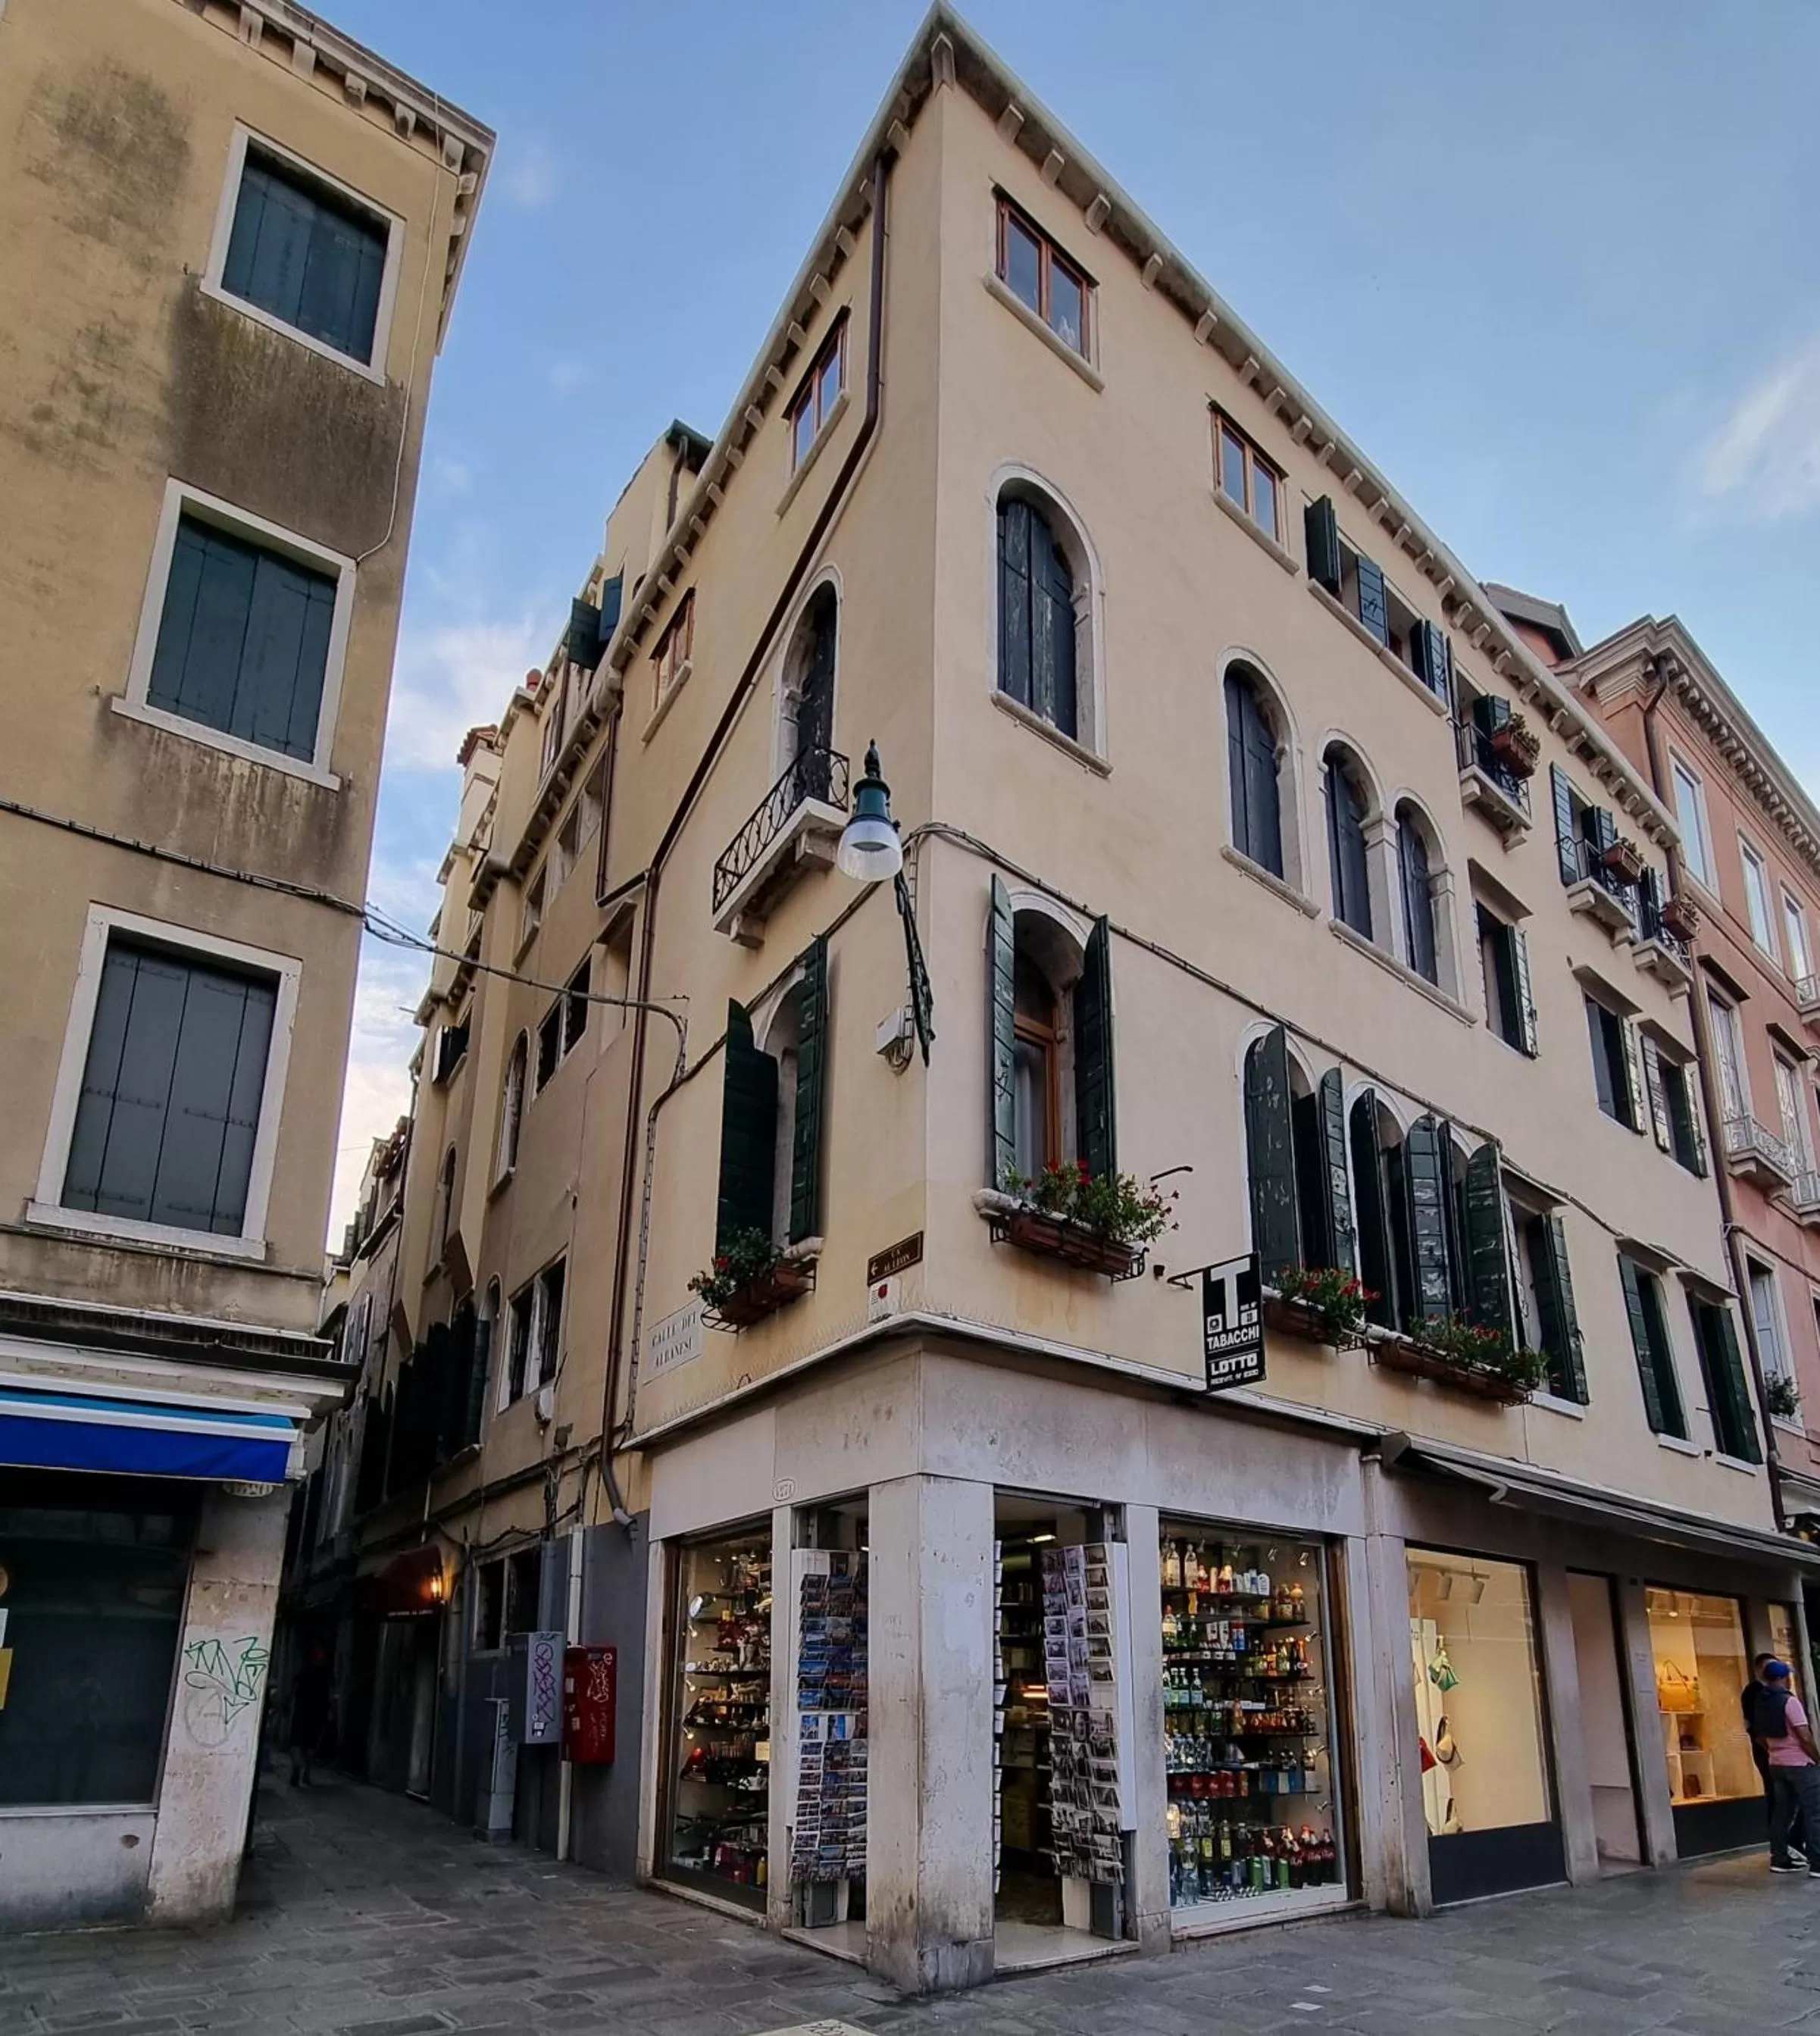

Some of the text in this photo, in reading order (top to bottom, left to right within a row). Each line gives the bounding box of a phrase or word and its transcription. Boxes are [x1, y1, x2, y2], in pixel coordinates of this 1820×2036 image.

[1211, 1256, 1250, 1330] T
[652, 1323, 677, 1347] CALLE
[1206, 1324, 1260, 1350] TABACCHI
[654, 1337, 692, 1368] ALBANESI
[1211, 1352, 1258, 1375] LOTTO
